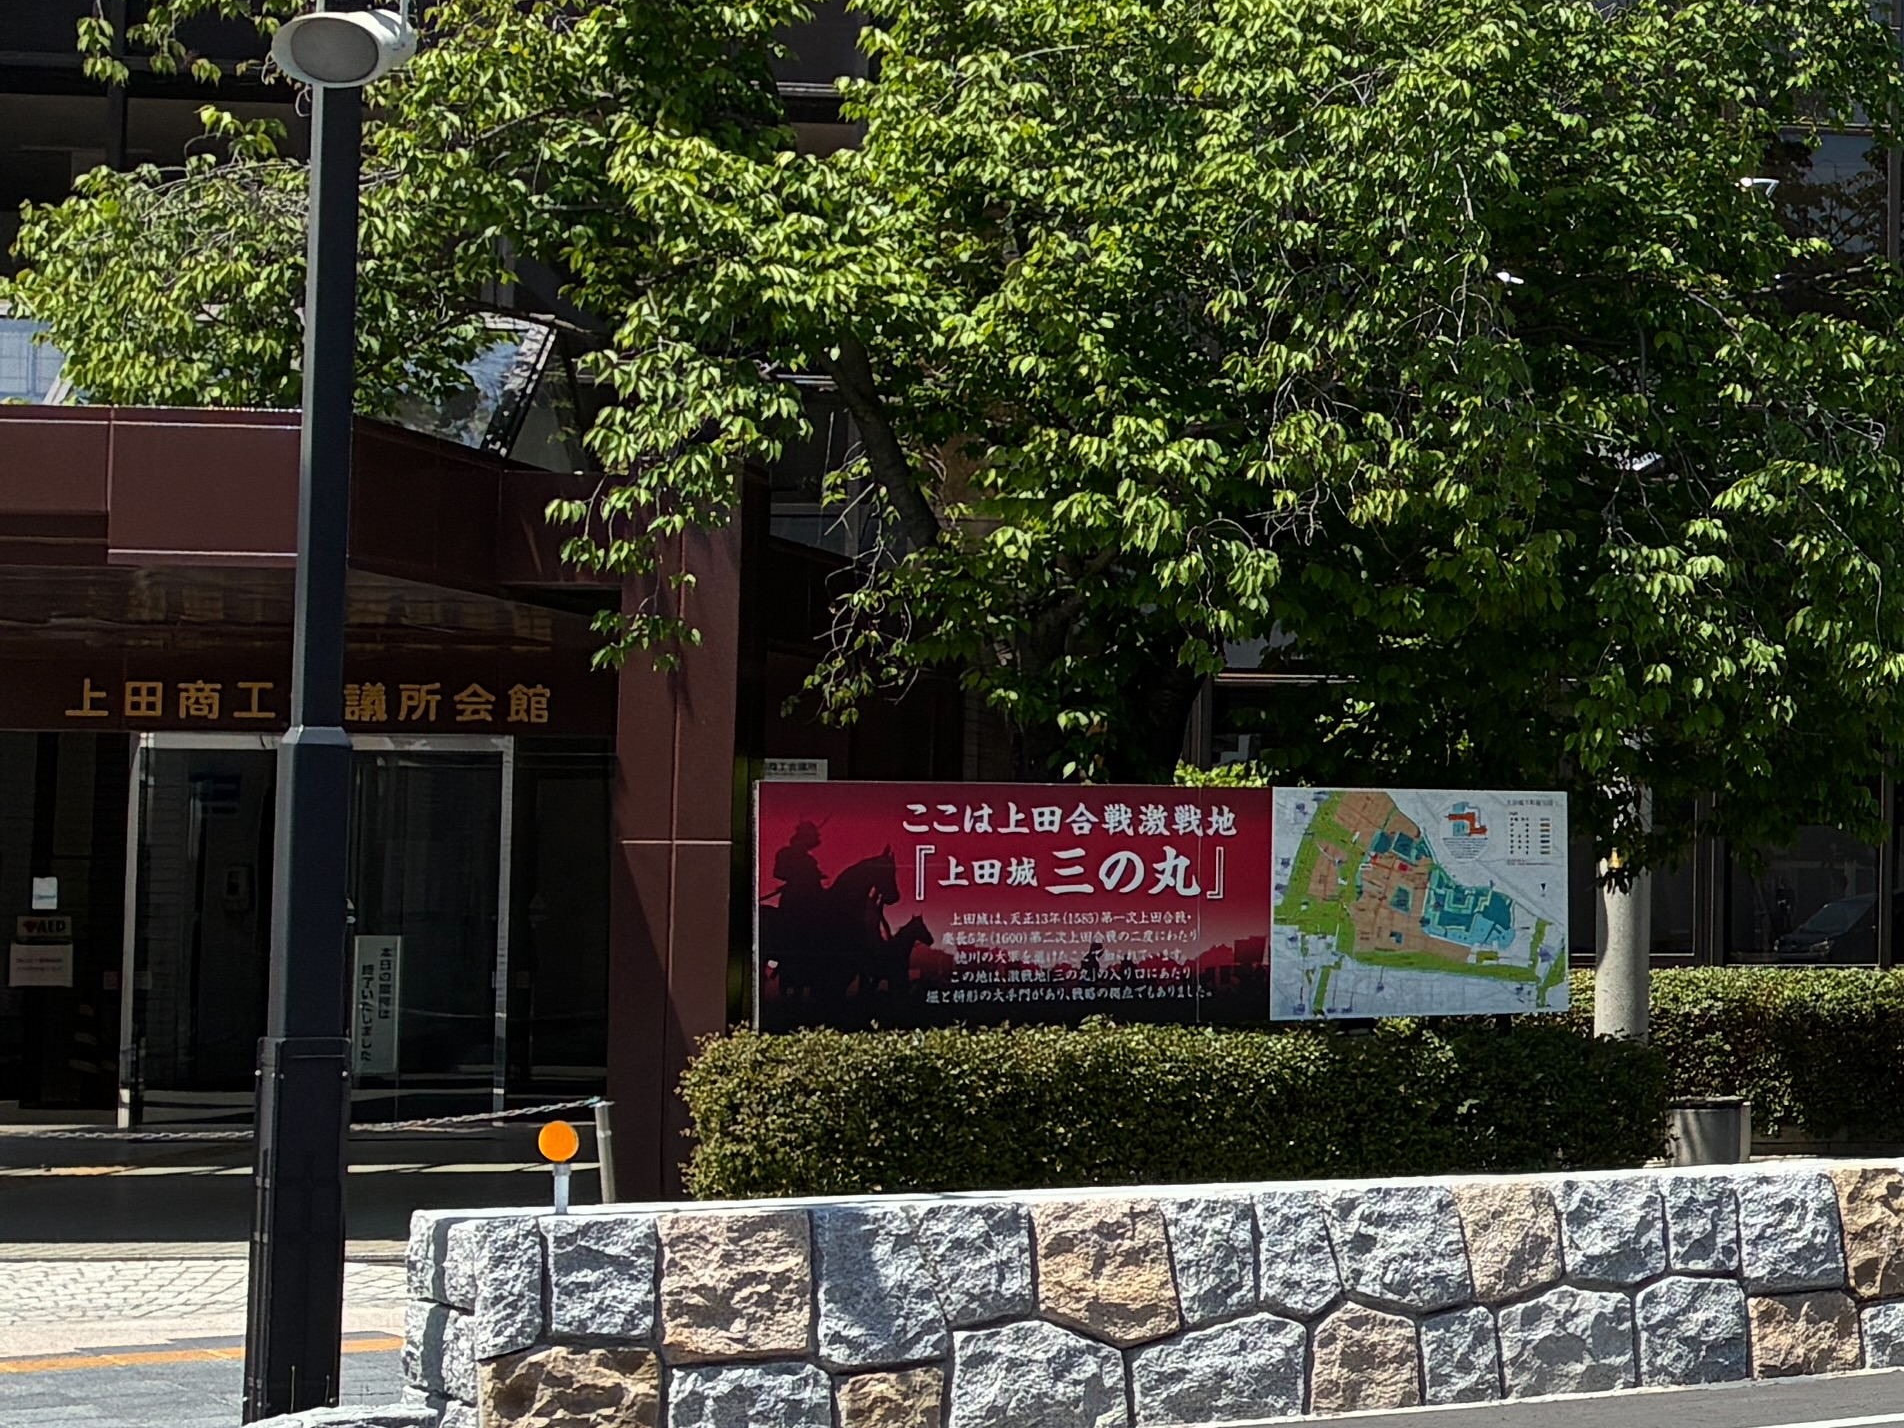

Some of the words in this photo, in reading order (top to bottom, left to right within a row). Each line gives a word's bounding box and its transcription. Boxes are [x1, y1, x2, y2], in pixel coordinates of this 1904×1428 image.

[65, 678, 551, 724] 上田商工議所会館
[903, 802, 1237, 836] ここは上田合戦激戦地
